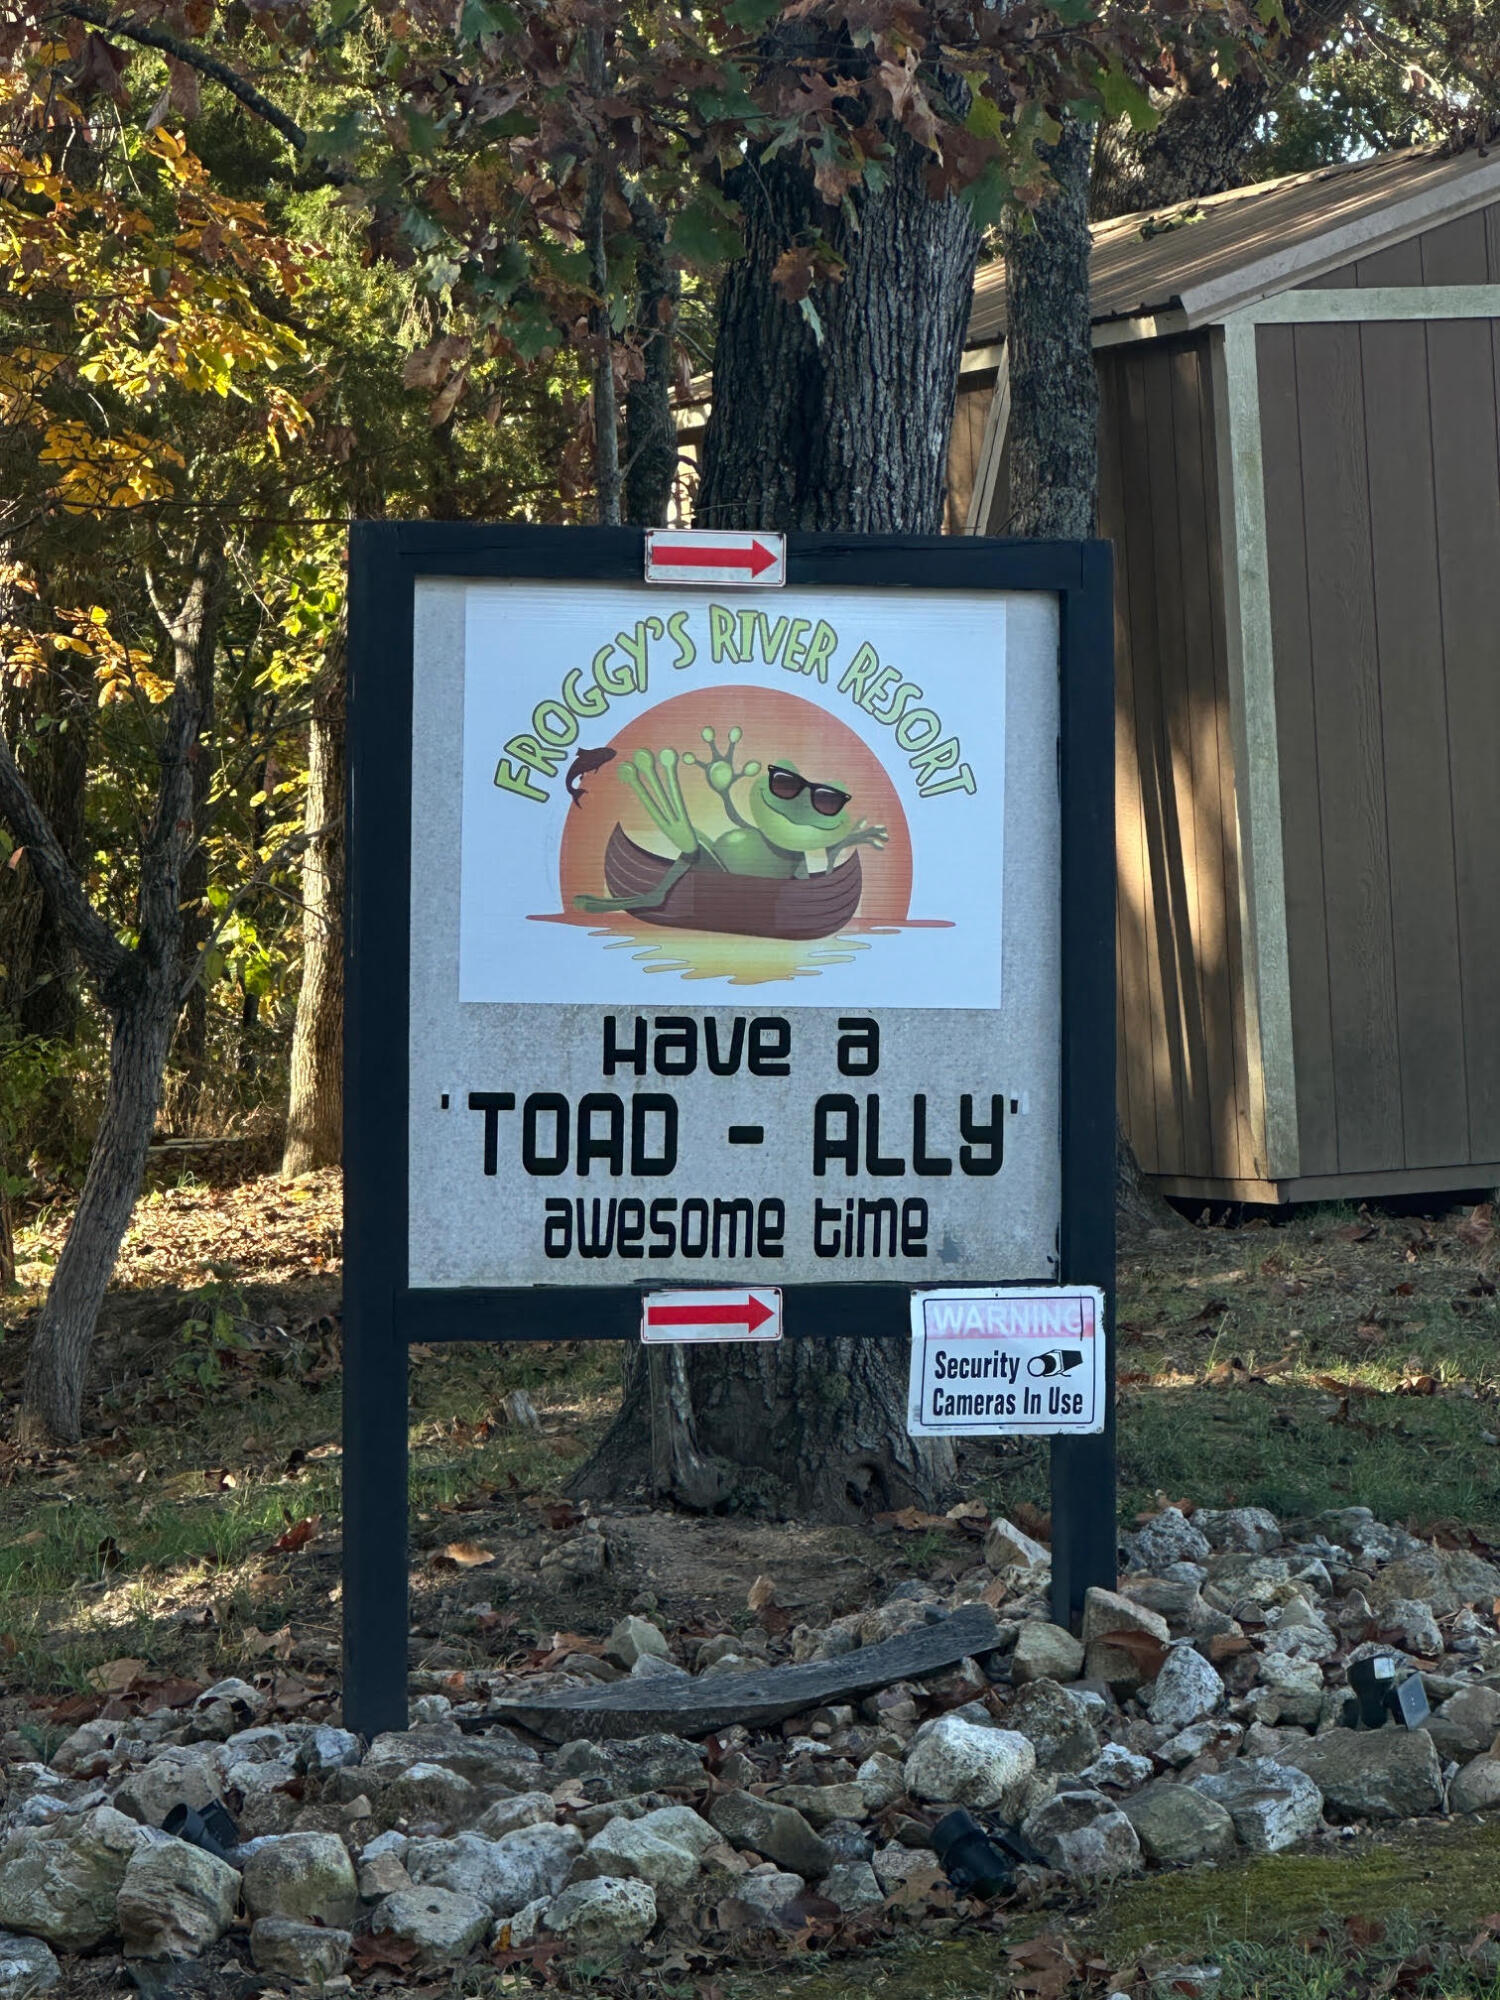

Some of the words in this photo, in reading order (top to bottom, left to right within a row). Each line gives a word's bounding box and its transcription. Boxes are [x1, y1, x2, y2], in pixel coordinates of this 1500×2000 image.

[494, 611, 697, 803] FROGGY'S
[709, 603, 839, 683] RIVER
[838, 641, 977, 799] RESORT
[602, 1015, 791, 1076] Have
[837, 1017, 880, 1076] a
[544, 1197, 785, 1258] awesome
[813, 1197, 929, 1258] time
[933, 1304, 1082, 1336] WARNING
[934, 1350, 1021, 1384] Security
[932, 1387, 1017, 1417] Cameras
[1023, 1386, 1041, 1415] In
[1049, 1386, 1084, 1415] Use
